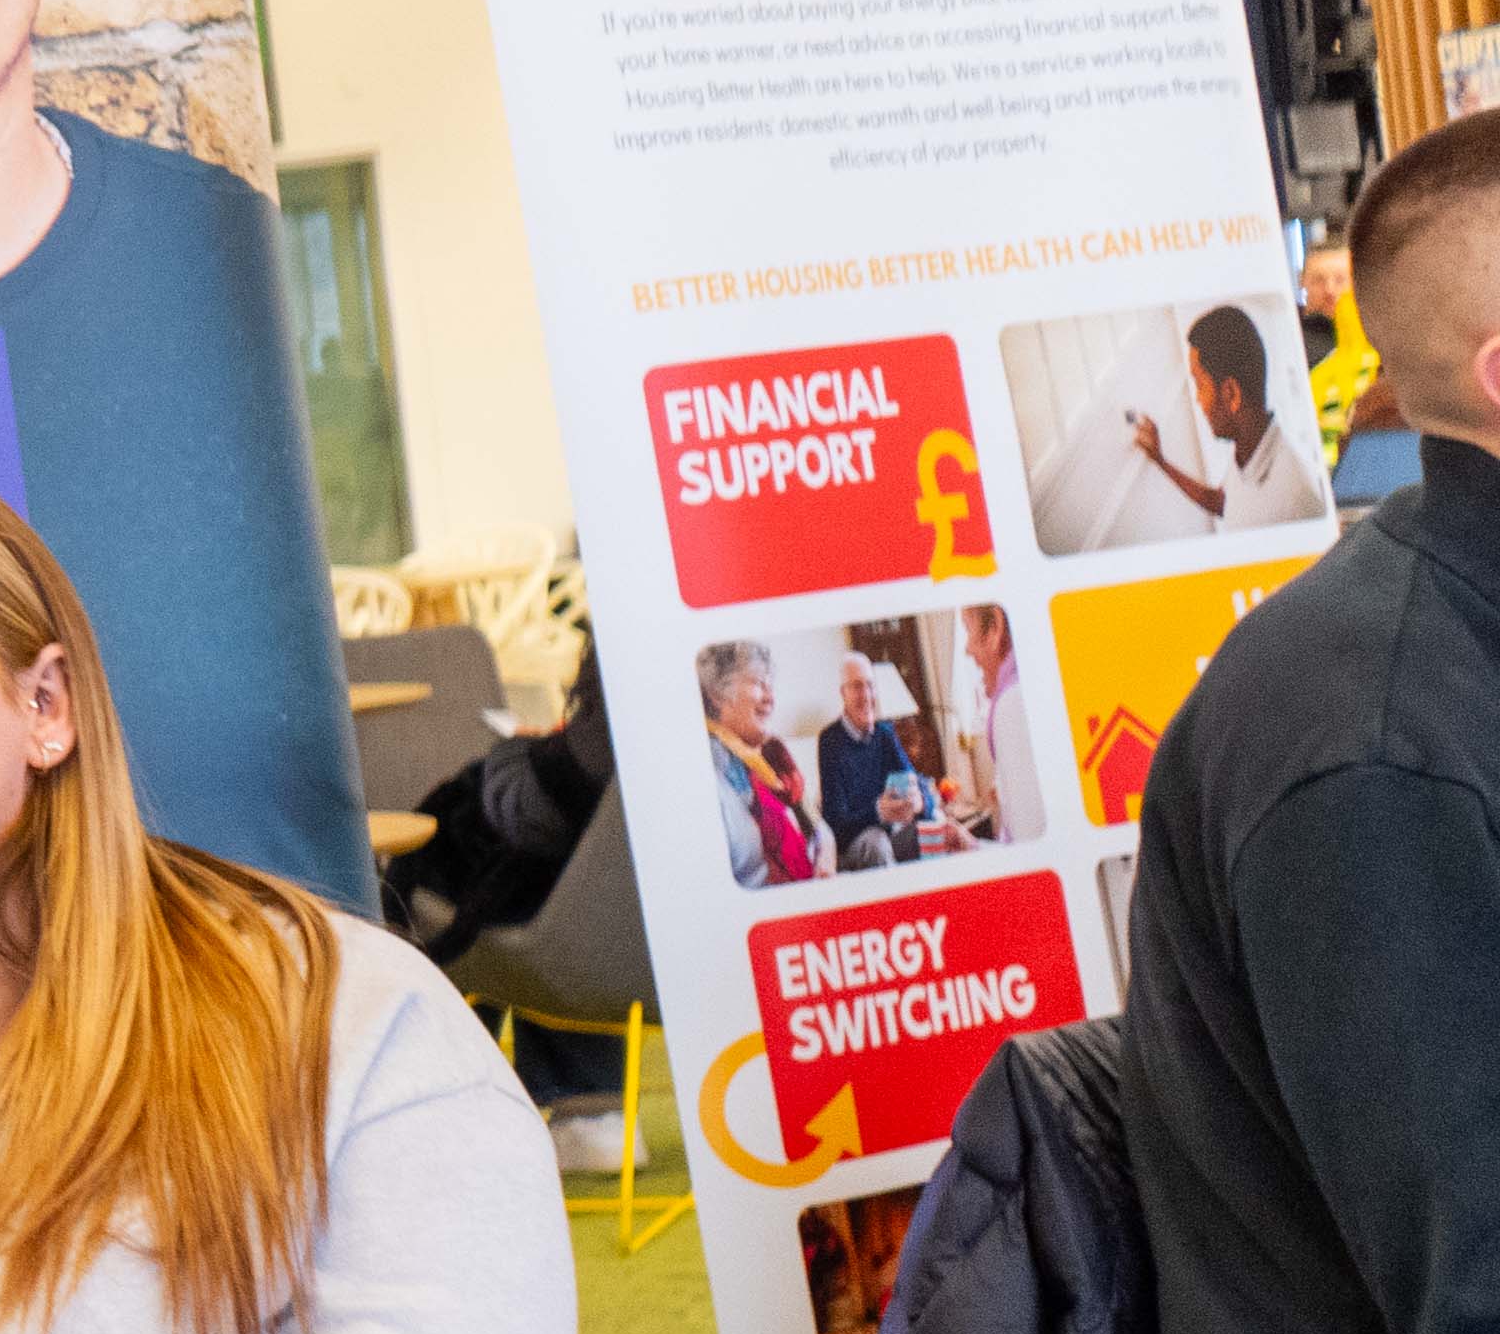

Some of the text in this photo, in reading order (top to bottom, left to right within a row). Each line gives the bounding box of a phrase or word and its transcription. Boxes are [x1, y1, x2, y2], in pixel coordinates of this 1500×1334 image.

[626, 87, 705, 112] Housing
[633, 273, 742, 314] BETTER
[745, 260, 864, 302] HOUSING
[868, 251, 959, 289] BETTER
[966, 237, 1076, 280] HEALTH
[1081, 229, 1145, 264] CAN
[1150, 219, 1216, 255] HELP
[664, 365, 899, 445] FINANCIAL
[677, 431, 877, 506] SUPPORT
[774, 915, 948, 1001] ENERGY
[788, 965, 1037, 1062] SWITCHING
